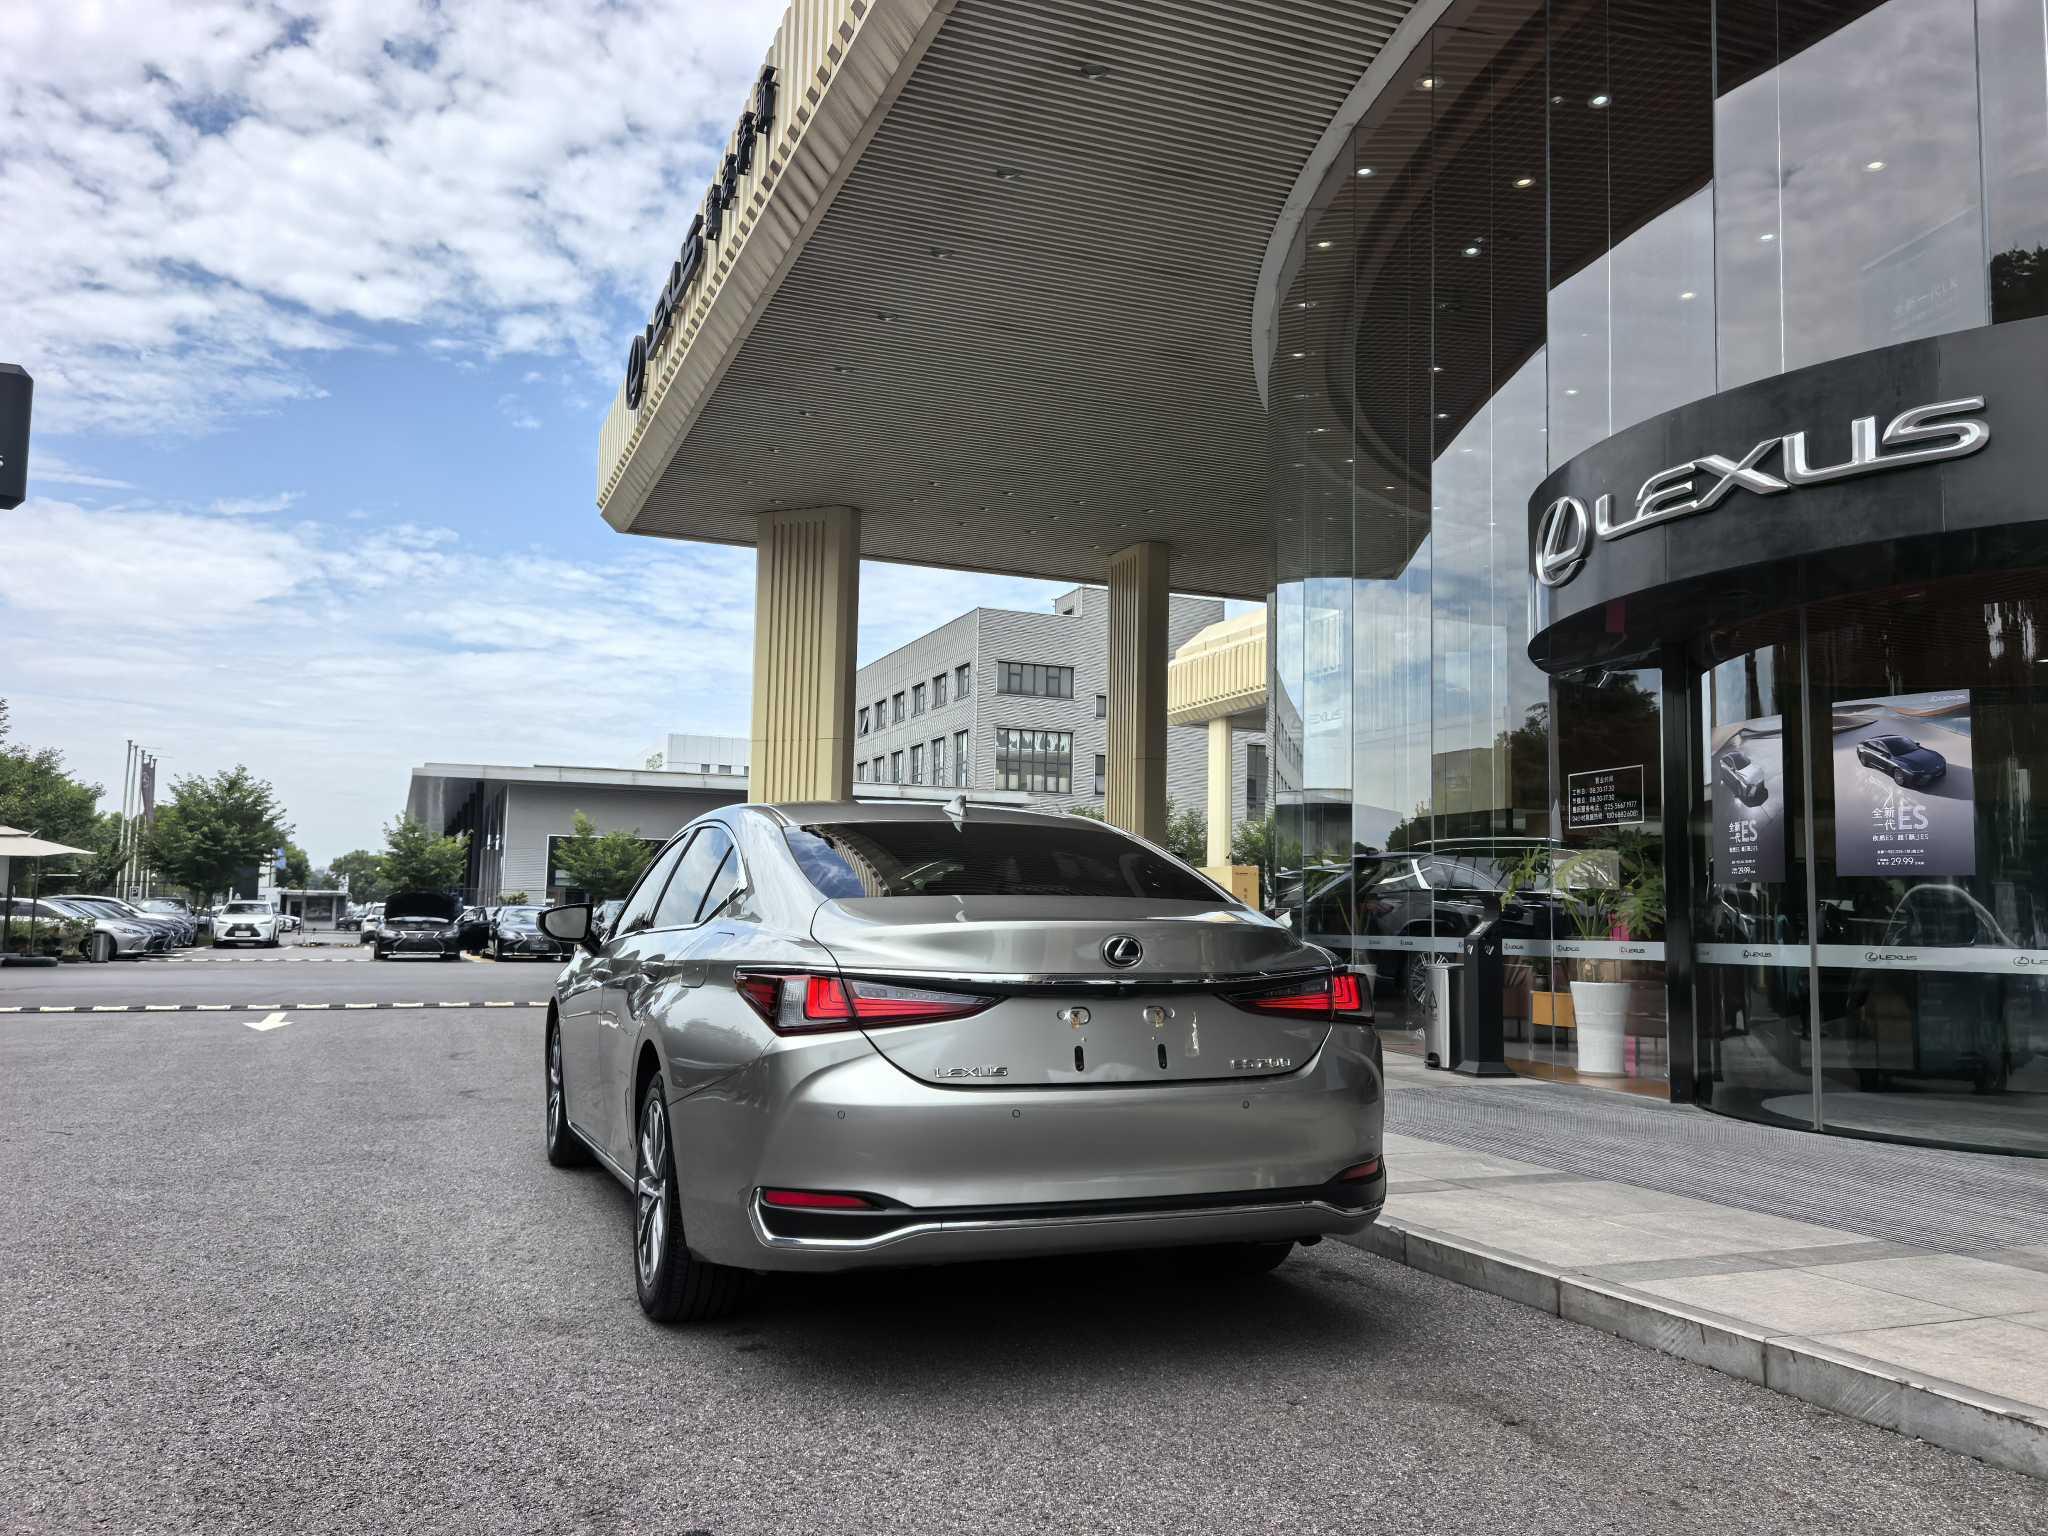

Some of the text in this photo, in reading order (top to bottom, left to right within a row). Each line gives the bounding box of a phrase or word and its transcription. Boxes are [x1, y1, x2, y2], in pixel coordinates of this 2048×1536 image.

[1594, 394, 1990, 541] LEXUS
[1872, 806, 1896, 819] 全新
[1897, 805, 1928, 830] ES
[1741, 820, 1758, 842] ES
[1872, 819, 1896, 831] 一代
[1890, 857, 1914, 866] 29.99
[1879, 953, 1920, 961] LEXUS
[935, 1066, 1009, 1079] LEXUS
